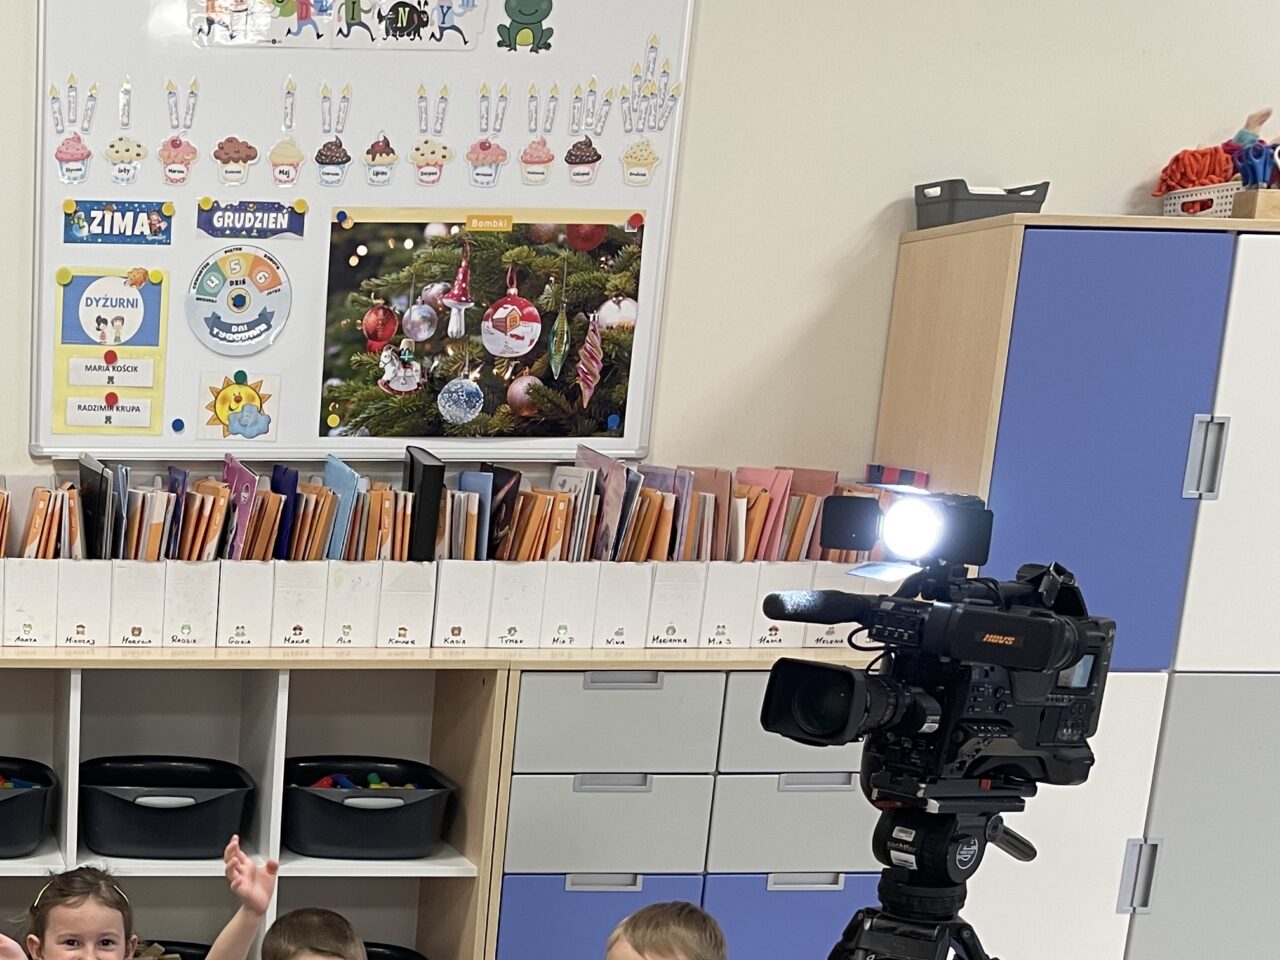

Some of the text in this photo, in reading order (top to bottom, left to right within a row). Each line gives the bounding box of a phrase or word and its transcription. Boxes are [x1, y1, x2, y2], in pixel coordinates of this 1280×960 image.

[278, 169, 290, 178] Maj
[89, 210, 151, 236] ZIMA
[213, 209, 289, 229] GRUDZIEŃ
[471, 218, 508, 228] Bombki
[229, 258, 241, 274] 5
[206, 275, 220, 288] 4
[256, 271, 270, 284] 6
[84, 294, 139, 309] DYŻURNI
[84, 363, 139, 373] MARIA KOŚCIK
[77, 403, 141, 413] RADZIMIR KRUPA
